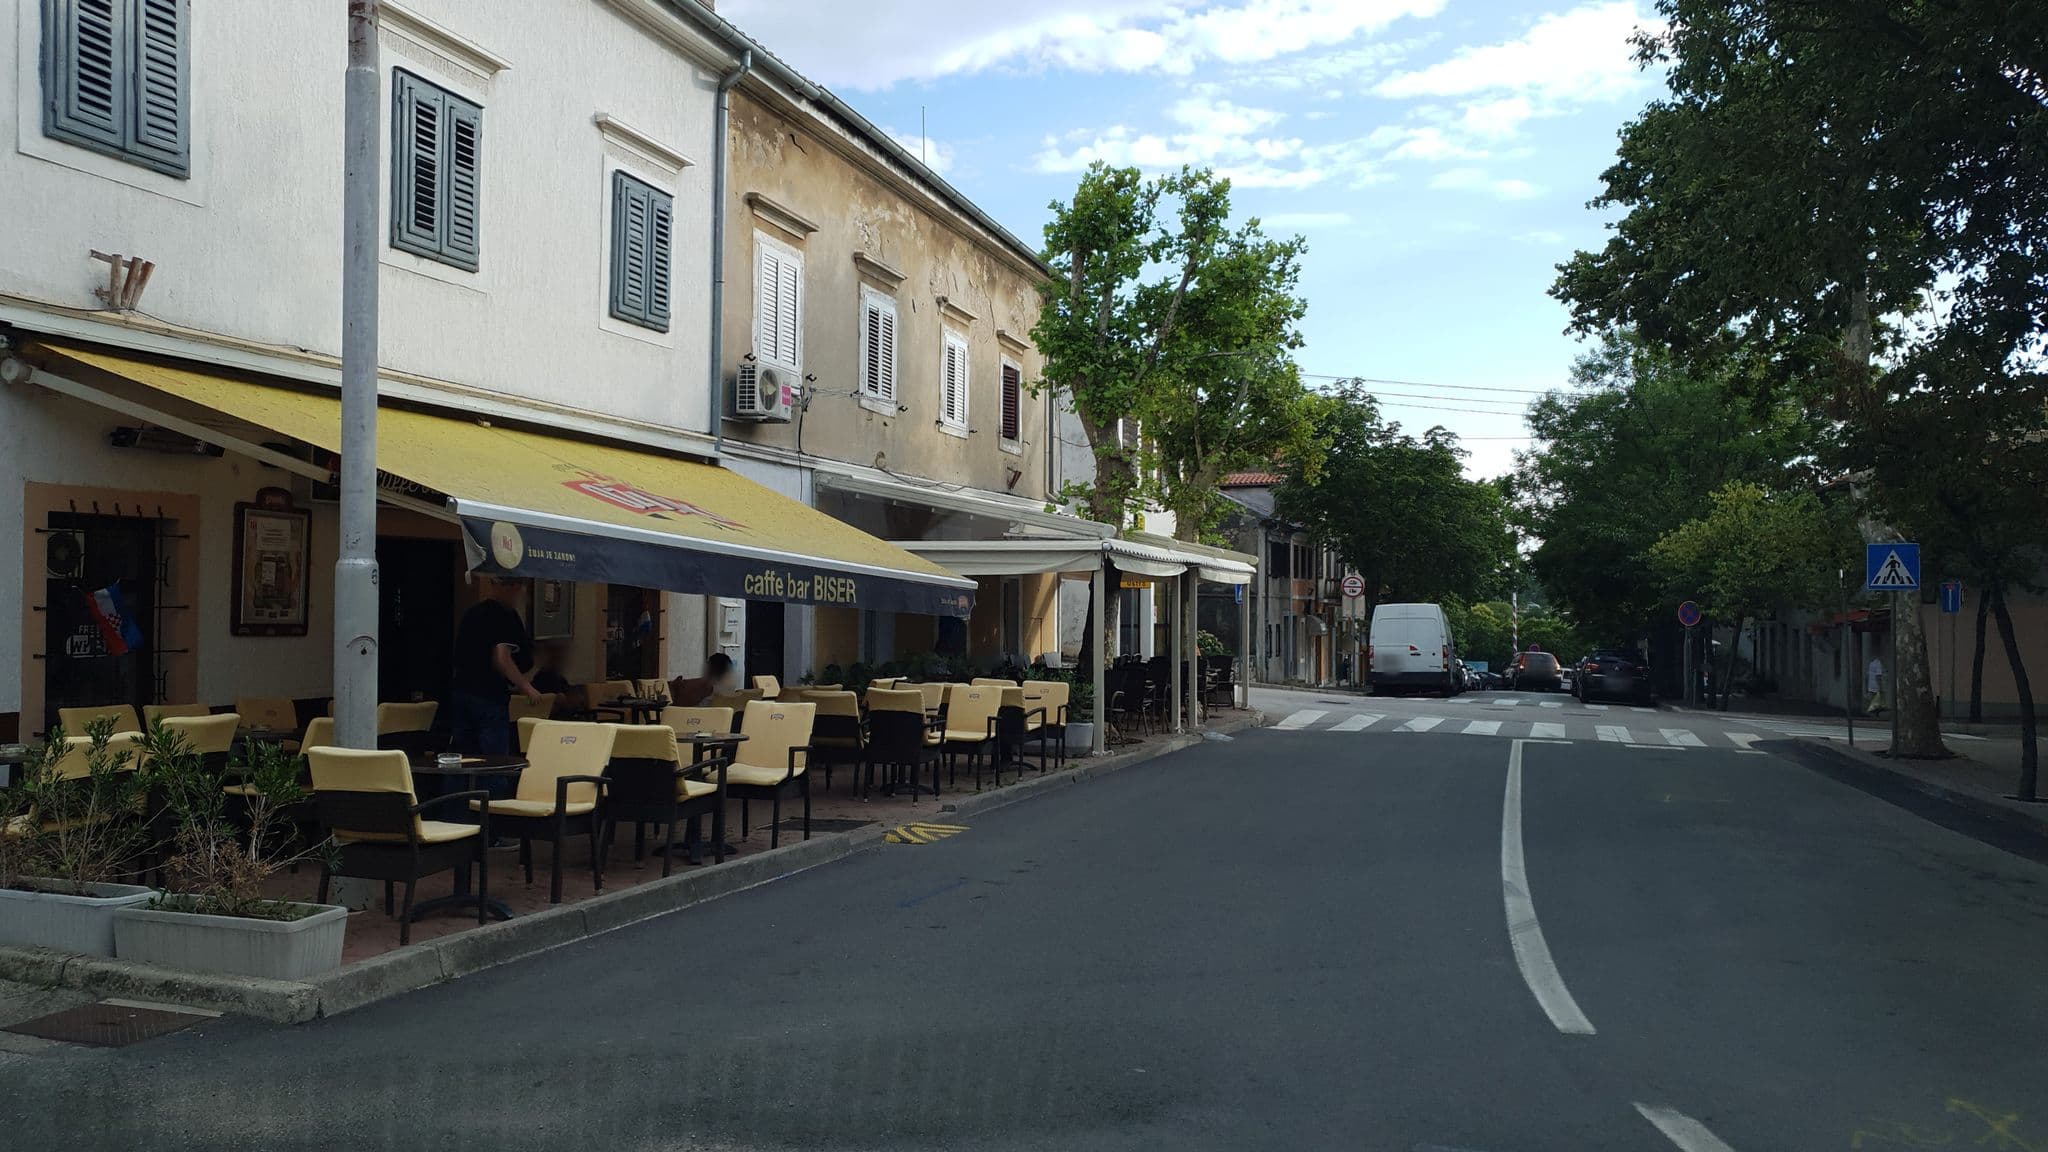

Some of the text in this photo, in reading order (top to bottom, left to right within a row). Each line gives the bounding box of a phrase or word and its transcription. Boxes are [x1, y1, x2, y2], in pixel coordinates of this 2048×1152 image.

[744, 569, 857, 603] caffe bar BISER
